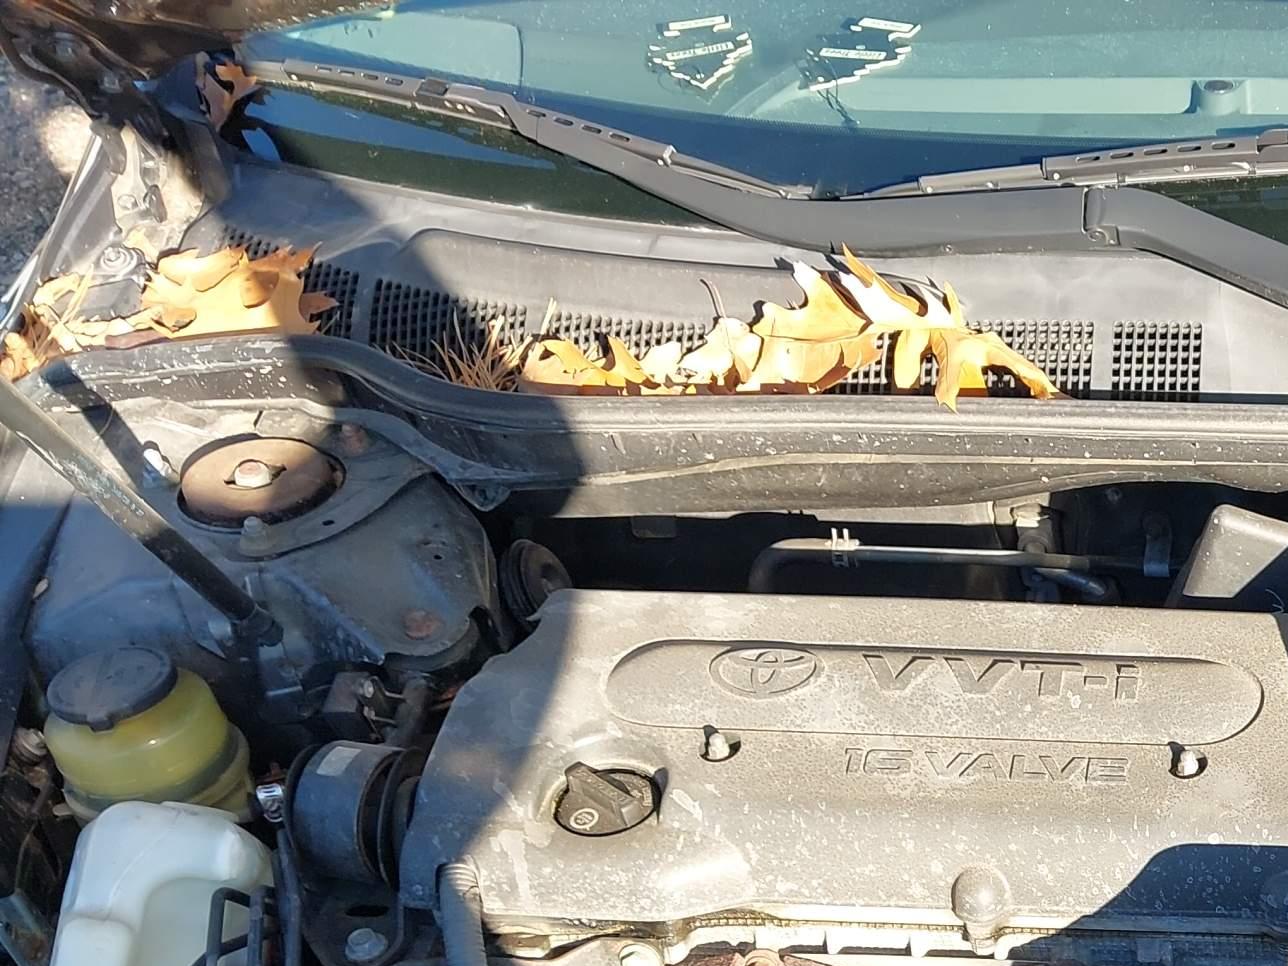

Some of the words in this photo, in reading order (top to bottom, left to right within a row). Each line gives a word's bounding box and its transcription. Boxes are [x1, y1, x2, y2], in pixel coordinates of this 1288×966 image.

[862, 653, 1140, 701] VVT-i
[845, 748, 914, 775] 16
[923, 751, 1130, 783] VALVE
